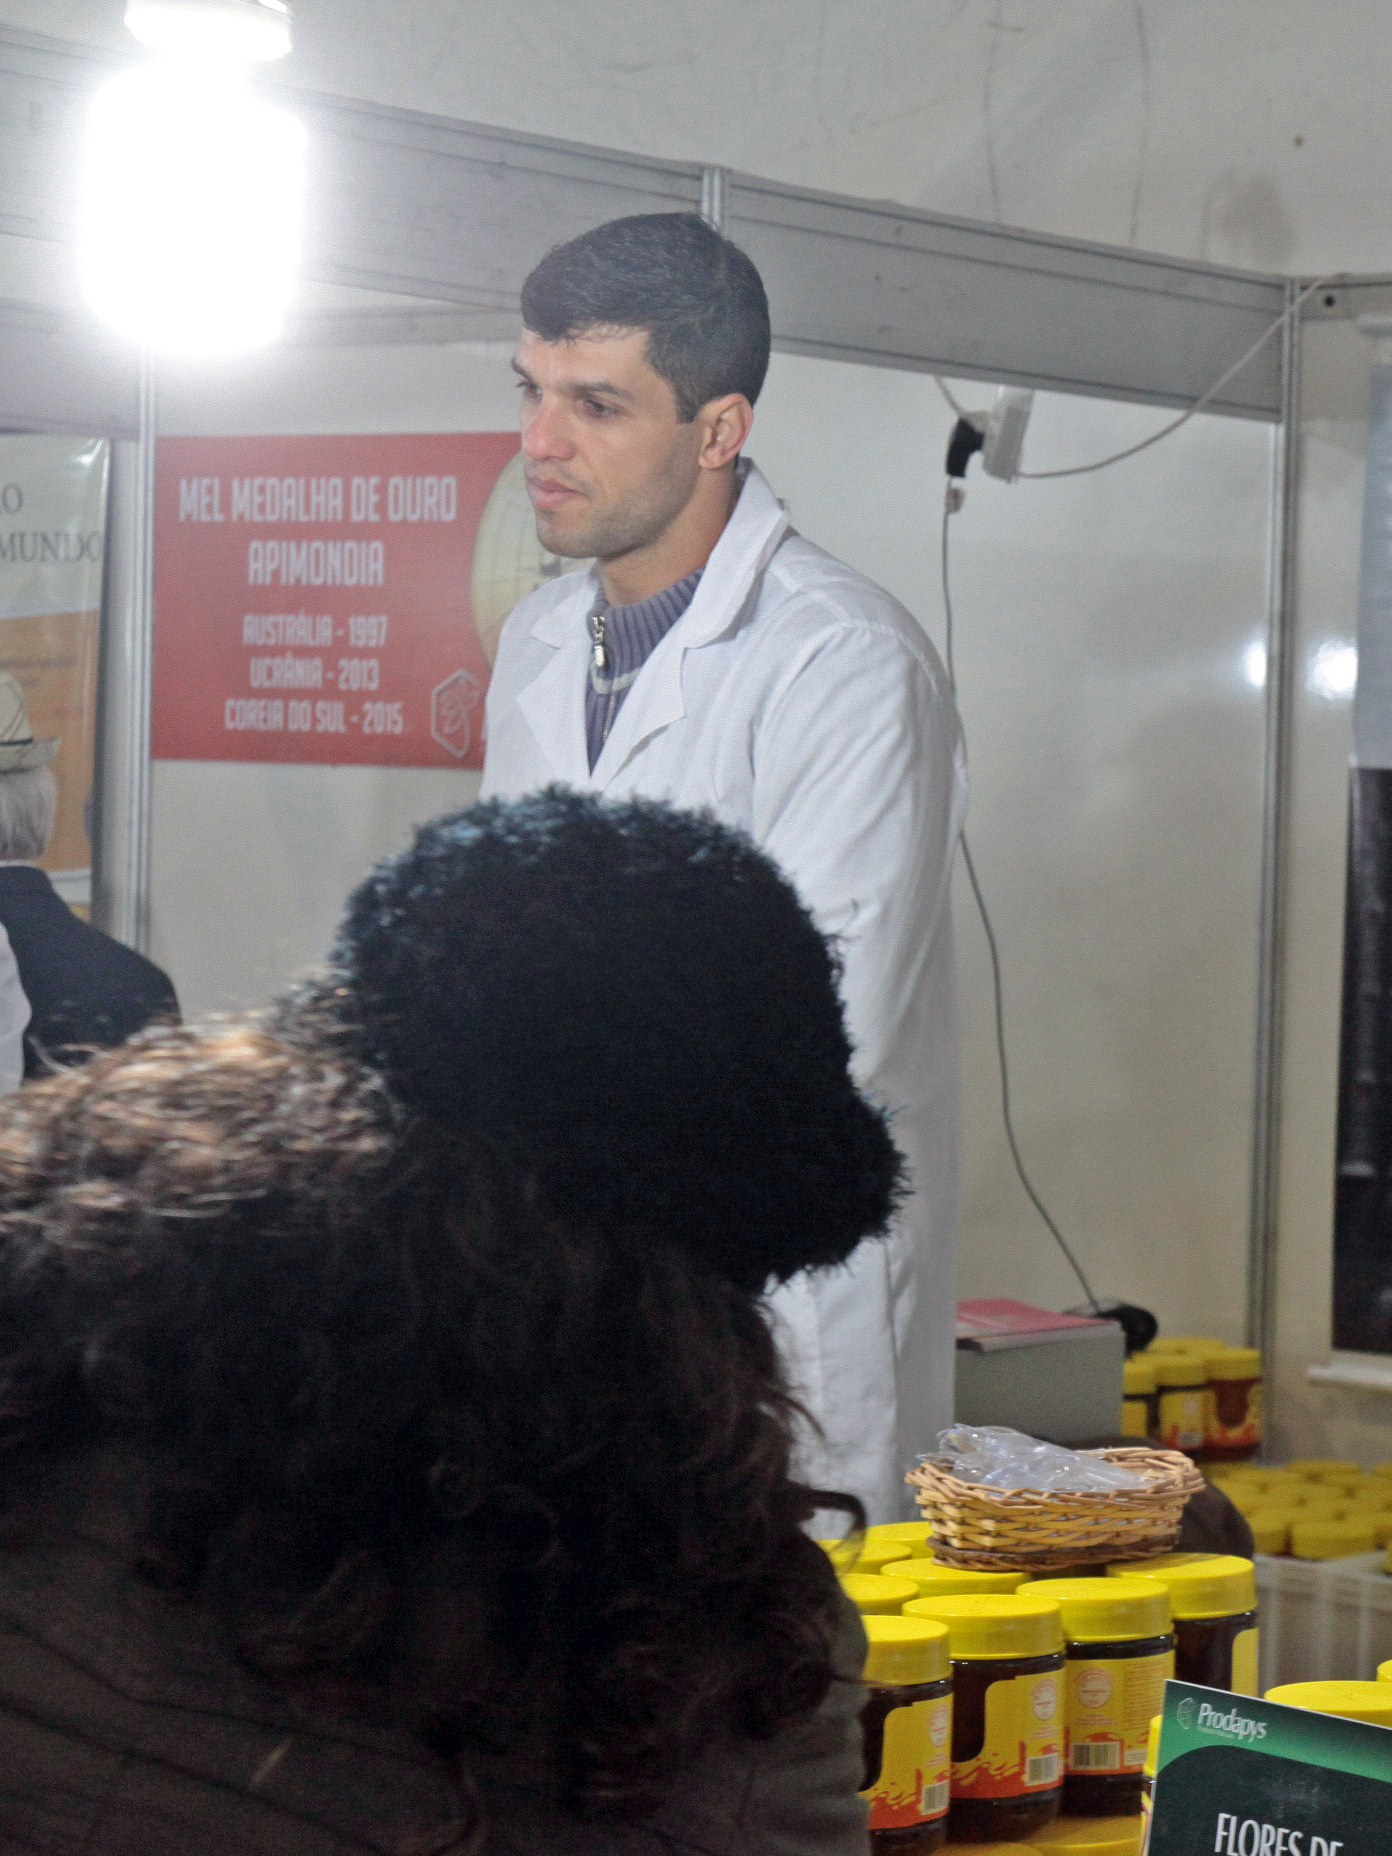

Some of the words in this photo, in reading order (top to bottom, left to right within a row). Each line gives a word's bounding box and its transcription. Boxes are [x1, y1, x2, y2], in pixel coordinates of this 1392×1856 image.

[179, 476, 225, 523] MEL
[232, 476, 344, 523] MEDALHA
[351, 476, 381, 522] DE
[388, 475, 458, 523] OURO
[247, 540, 385, 586] APIMONDIA
[243, 610, 332, 646] AUSTRÁLIA
[348, 616, 388, 648] 1997
[250, 652, 322, 689] UCRÂNIA
[338, 658, 380, 690] 2013
[225, 698, 284, 732] COREIA
[288, 700, 311, 732] DO
[315, 700, 346, 733] SUL
[362, 702, 404, 734] 2015
[1198, 1702, 1268, 1743] Prodapys
[1214, 1812, 1304, 1856] FLORES
